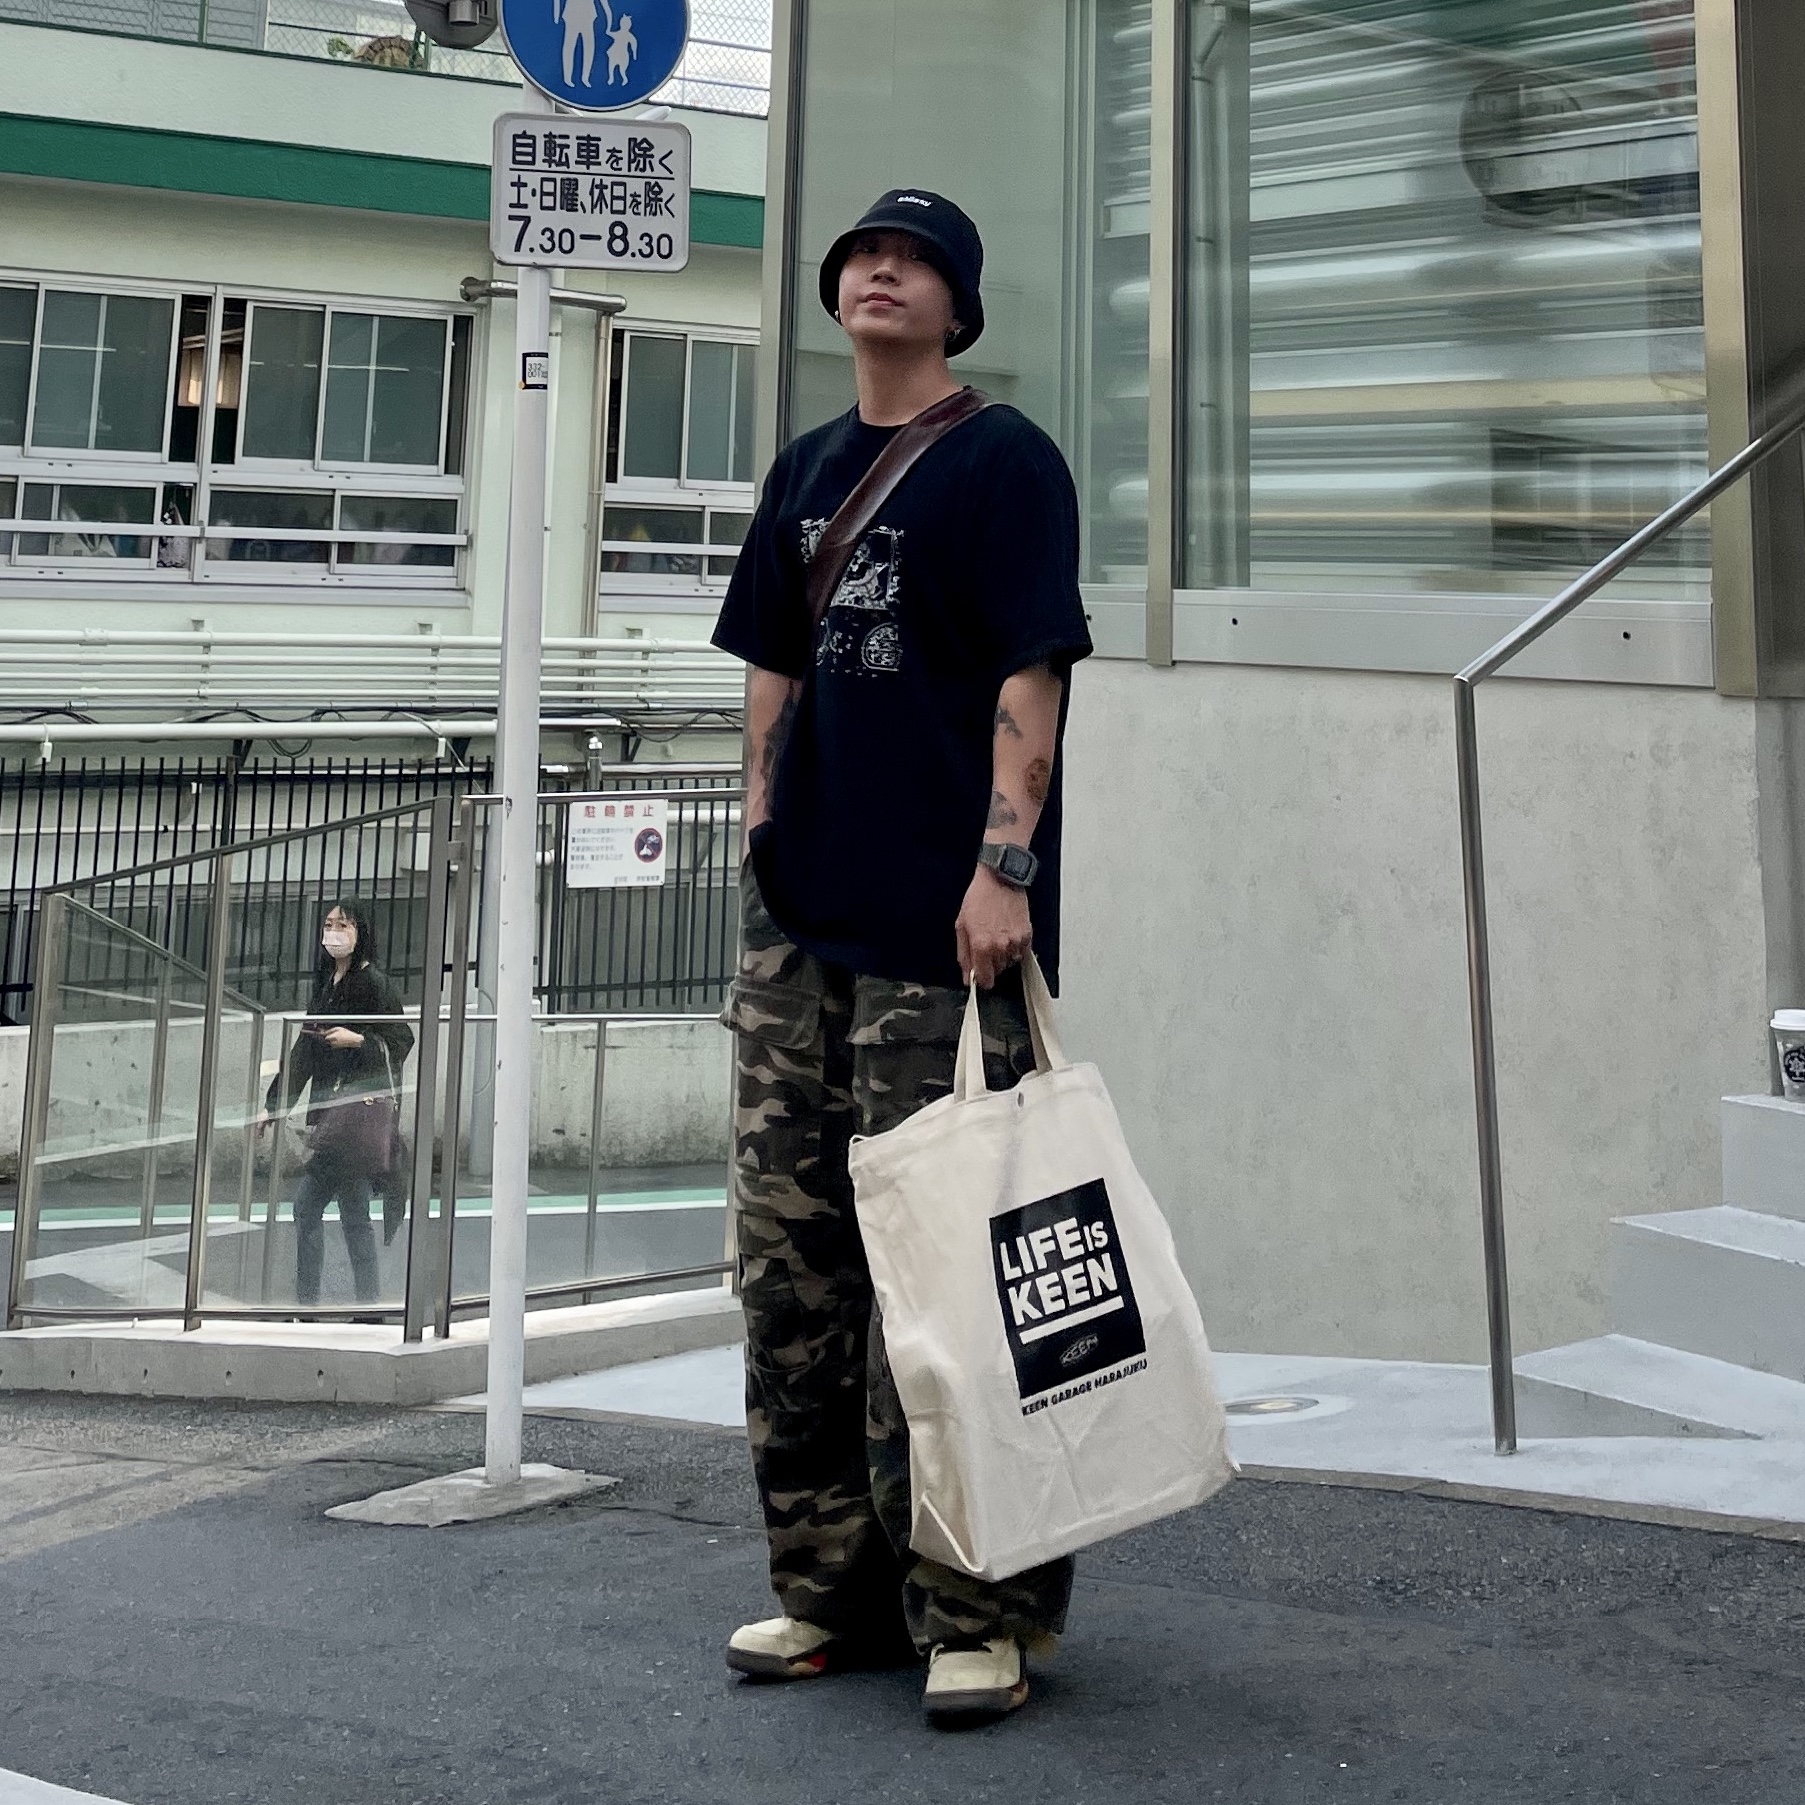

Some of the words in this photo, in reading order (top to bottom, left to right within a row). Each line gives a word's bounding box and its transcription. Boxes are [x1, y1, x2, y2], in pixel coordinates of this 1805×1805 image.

[511, 130, 674, 175] 自転車を除く
[508, 174, 675, 218] 土・日曜、休日を除く
[1000, 1217, 1085, 1281] LIFE
[1083, 1221, 1109, 1252] IS
[1007, 1252, 1118, 1326] KEEN
[1061, 1335, 1098, 1366] KEEN
[1022, 1397, 1049, 1417] KEEN
